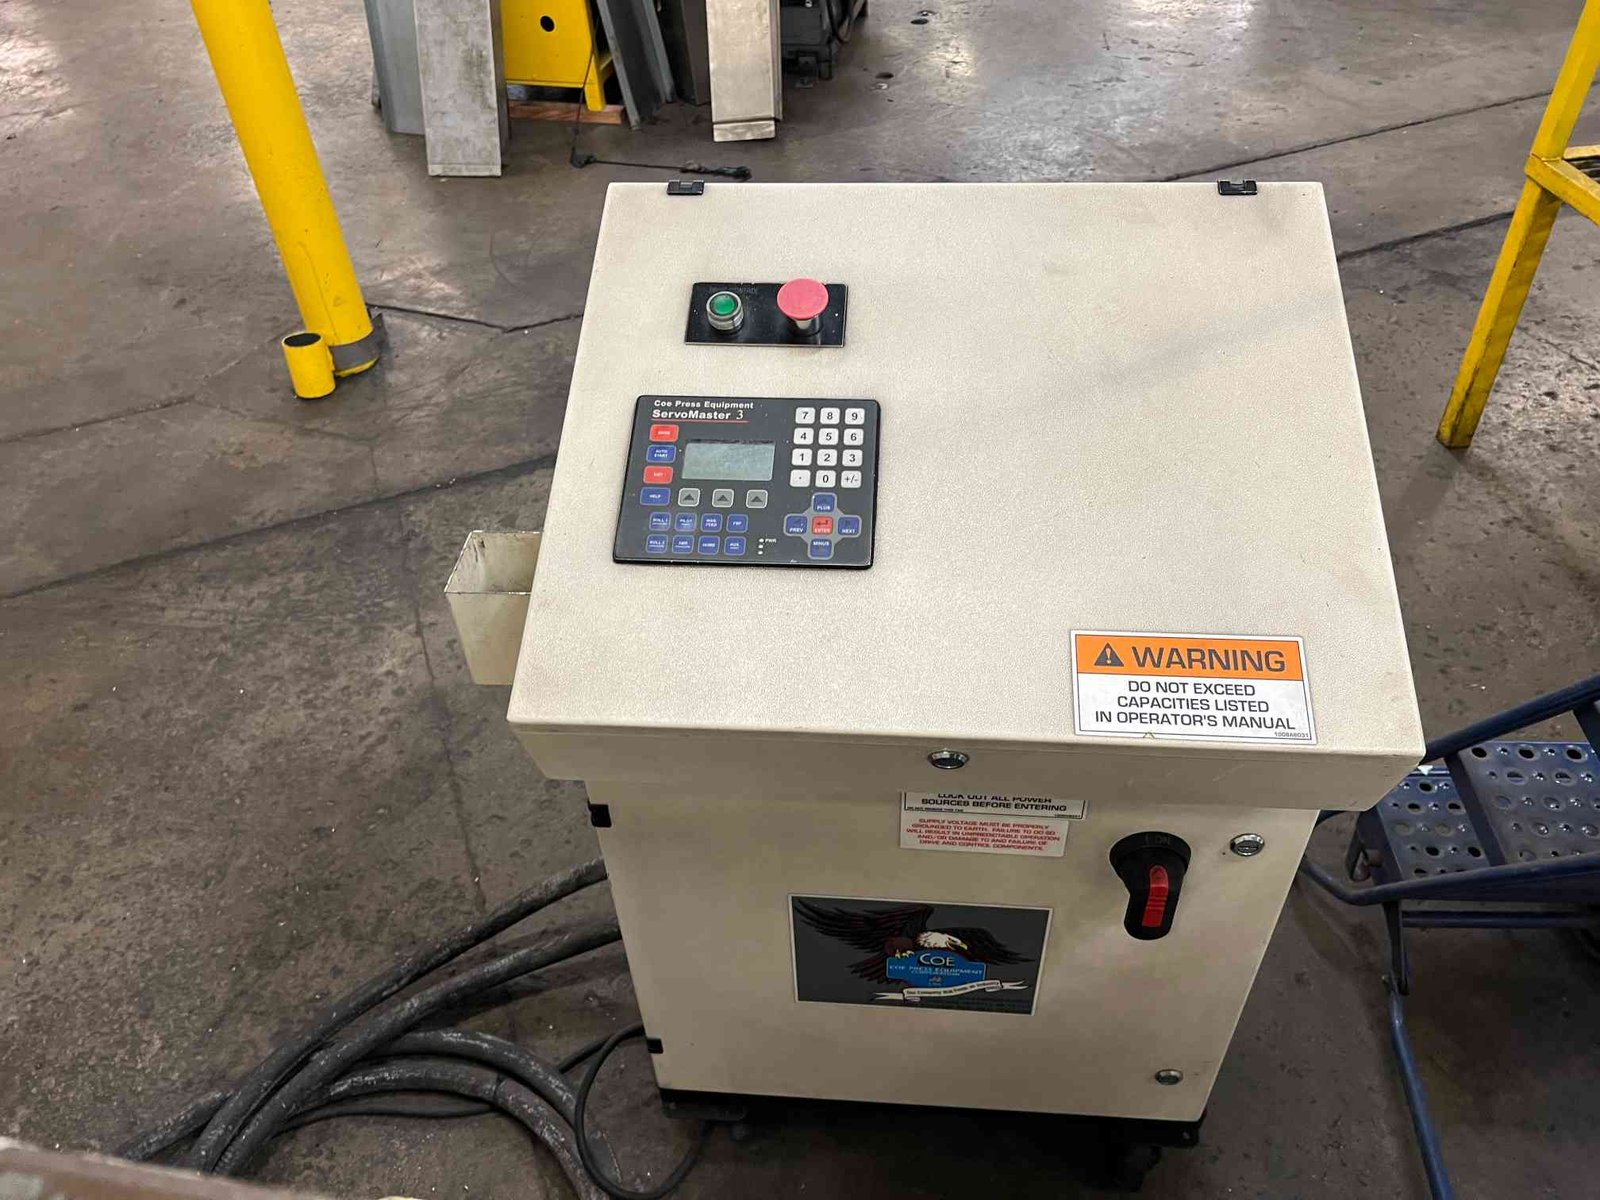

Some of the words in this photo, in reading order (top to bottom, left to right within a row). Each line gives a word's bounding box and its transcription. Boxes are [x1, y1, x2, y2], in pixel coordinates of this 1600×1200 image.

[675, 400, 700, 408] Press
[704, 401, 754, 409] Equipment
[652, 409, 731, 419] ServoMaster
[736, 409, 744, 420] 3
[802, 411, 808, 419] 7
[827, 412, 833, 420] 8
[851, 412, 858, 420] 9
[800, 432, 807, 440] 4
[825, 432, 832, 441] 5
[850, 433, 857, 441] 6
[800, 453, 804, 461] 1
[824, 453, 830, 462] 2
[849, 454, 856, 462] 3
[822, 475, 829, 483] 0
[845, 475, 858, 483] +/-
[1131, 646, 1286, 673] WARNING
[1128, 680, 1151, 693] DO
[1156, 682, 1189, 694] NOT
[1194, 683, 1255, 696] EXCEED
[1117, 696, 1210, 710] CAPACITIES
[1215, 700, 1269, 713] LISTED
[1095, 711, 1112, 723] IN
[1117, 712, 1218, 727] OPERATOR'S
[1222, 715, 1296, 730] MANUAL
[1014, 803, 1067, 811] ENTERING
[961, 831, 1019, 839] UNPREDICTABLE
[919, 953, 956, 967] COE
[935, 967, 983, 975] EQUIPMENT
